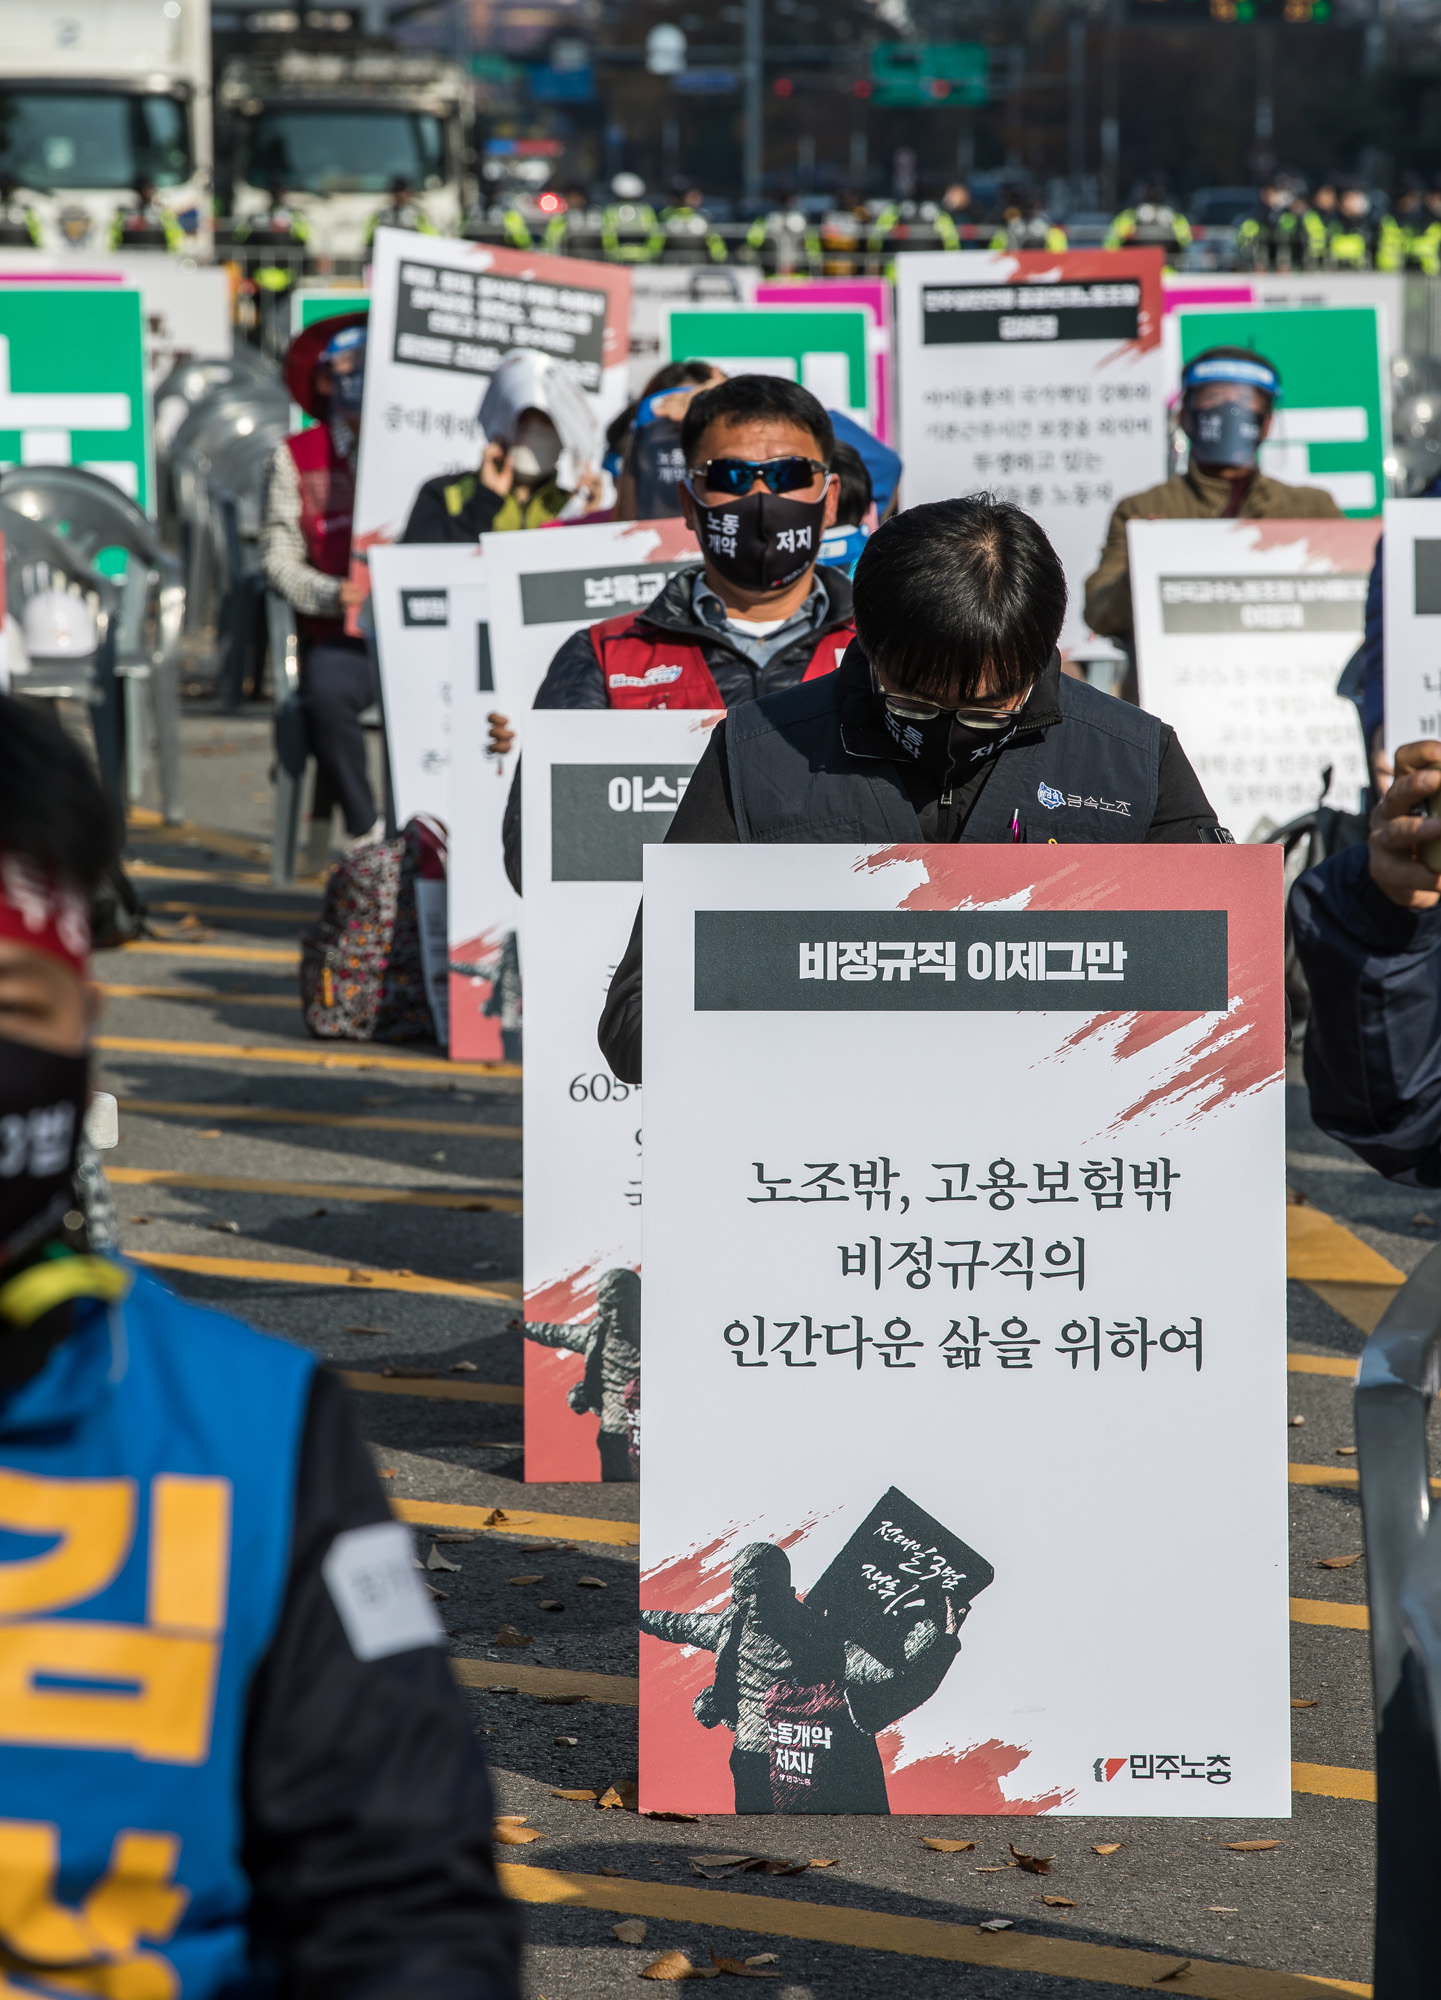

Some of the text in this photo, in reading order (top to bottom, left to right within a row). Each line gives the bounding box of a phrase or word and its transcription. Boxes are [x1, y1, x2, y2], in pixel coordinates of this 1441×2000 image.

[707, 511, 740, 536] 노동
[776, 525, 812, 553] 저지
[709, 533, 738, 558] 개악
[584, 572, 678, 608] 보육교
[1067, 793, 1131, 817] 금속노조
[799, 941, 1128, 982] 비정규직 이제그만
[569, 1072, 642, 1103] 605
[747, 1156, 1181, 1215] 노조밖, 고용보험밖
[837, 1235, 1086, 1292] 비정규직의
[723, 1315, 1203, 1373] 인간다운 삶을 위하여
[766, 1720, 833, 1750] 노동개악
[775, 1747, 815, 1775] 저지!
[1129, 1754, 1232, 1785] 민주노총
